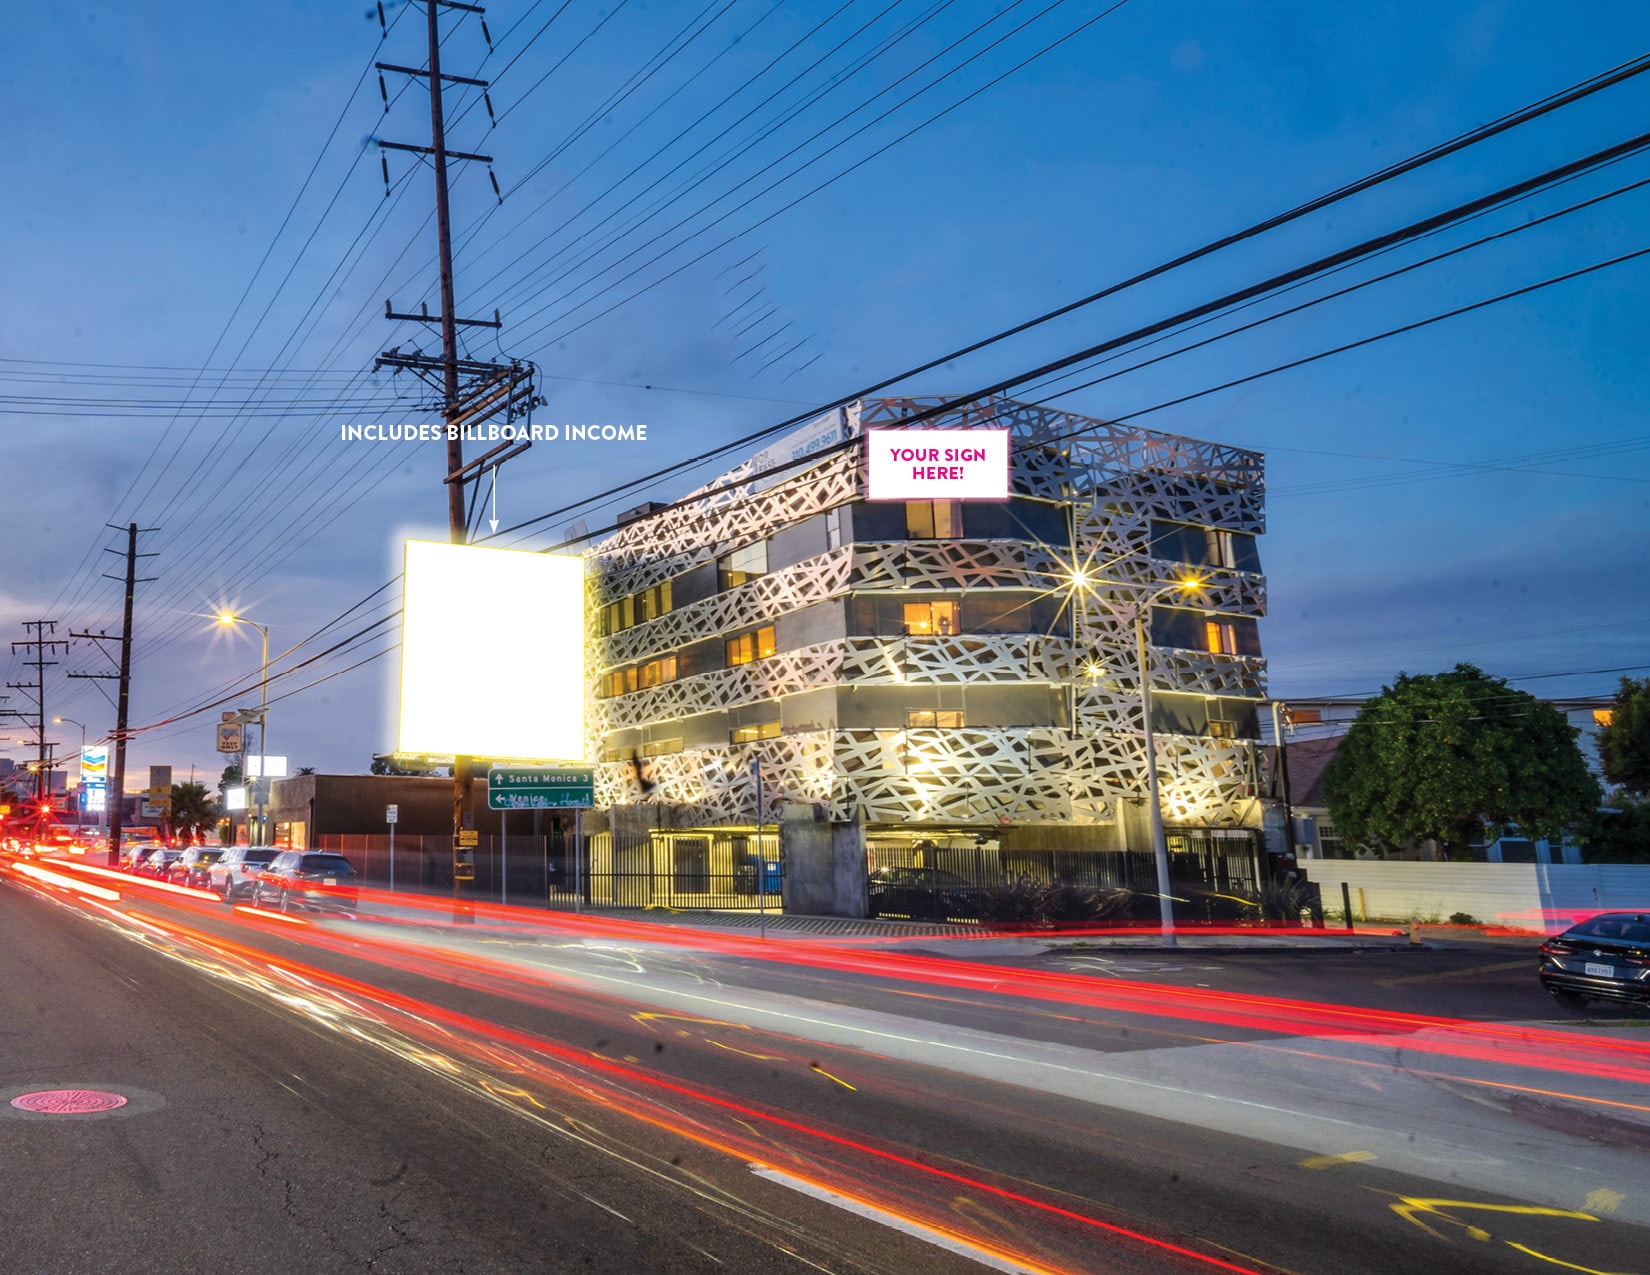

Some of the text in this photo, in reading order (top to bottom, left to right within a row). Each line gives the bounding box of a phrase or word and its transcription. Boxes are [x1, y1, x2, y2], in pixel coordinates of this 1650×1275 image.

[509, 773, 589, 784] Santa Monica 3
[511, 793, 545, 802] Venice
